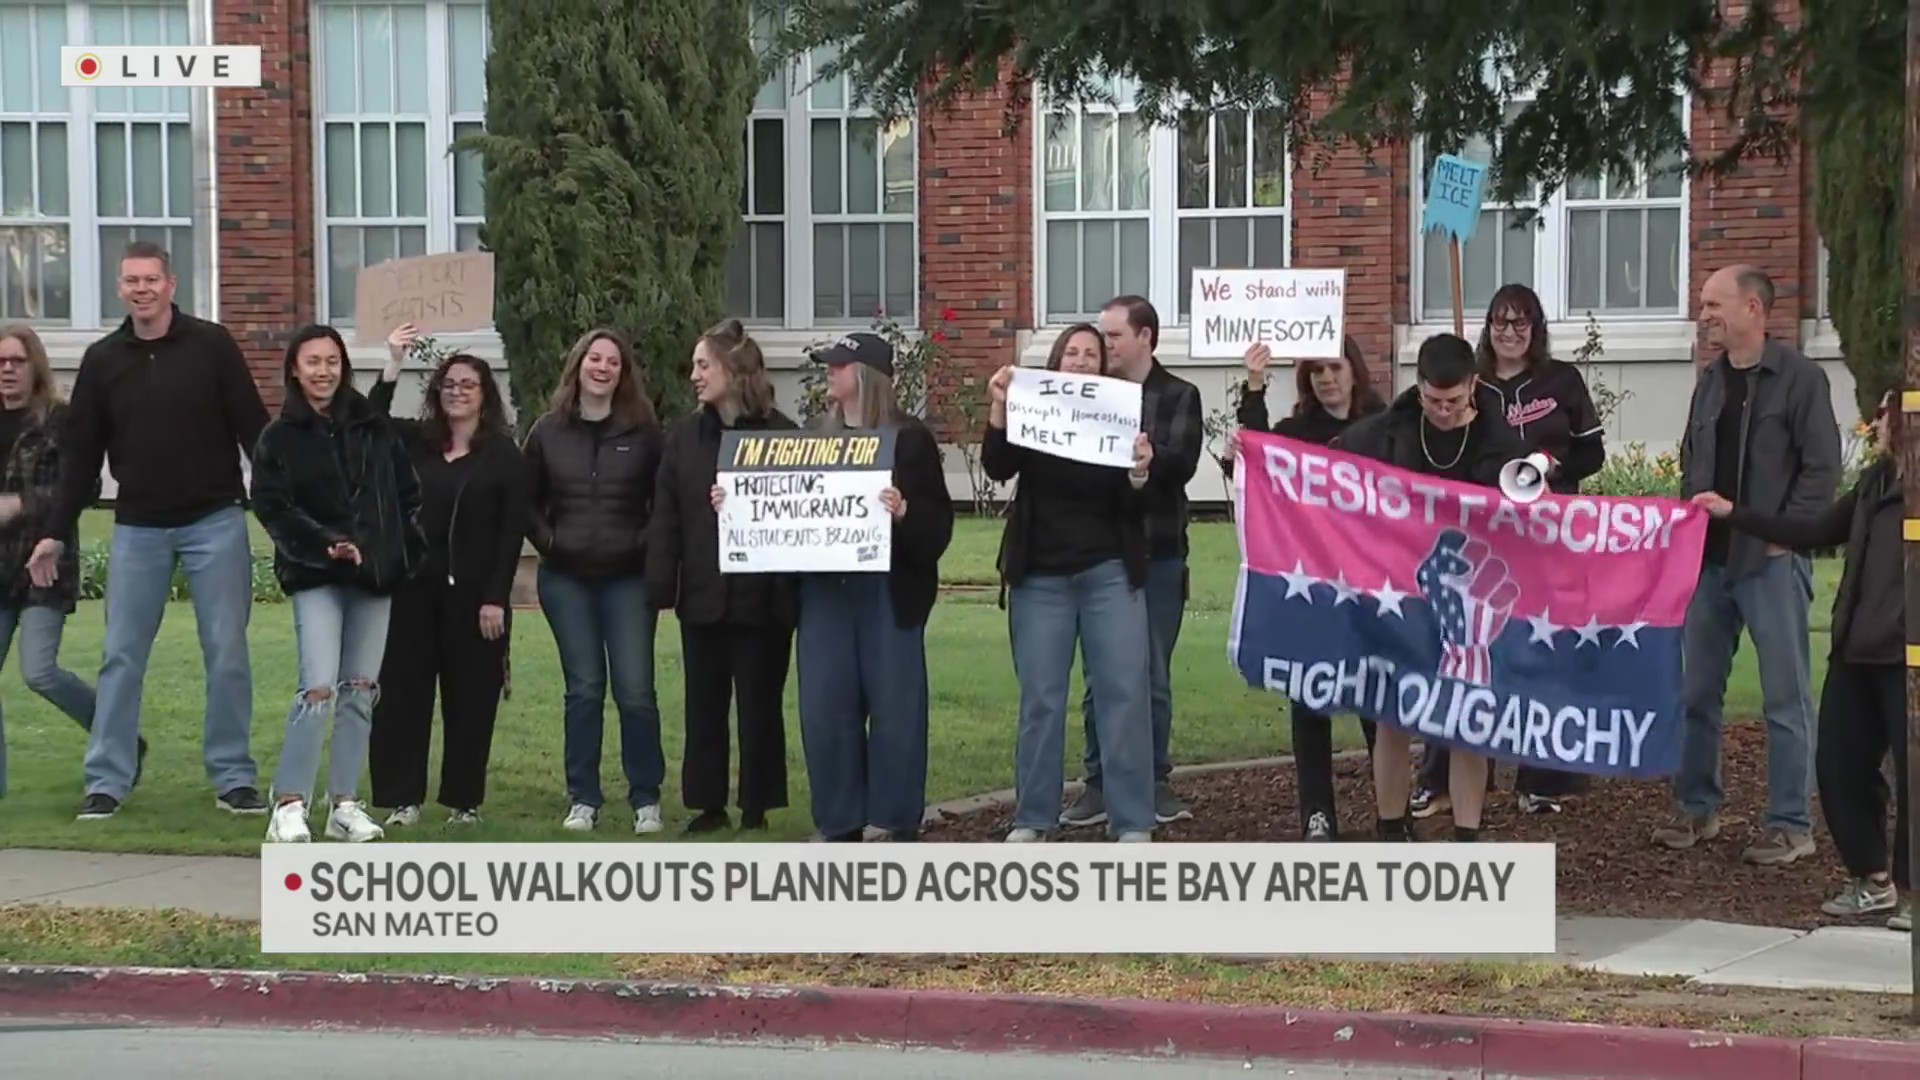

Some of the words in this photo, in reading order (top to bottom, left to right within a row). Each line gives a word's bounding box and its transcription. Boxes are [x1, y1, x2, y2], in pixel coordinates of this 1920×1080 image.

[1438, 158, 1480, 187] MELT
[1436, 182, 1472, 208] ICE
[1200, 276, 1232, 302] We
[1245, 278, 1297, 300] stand
[1305, 280, 1341, 297] with
[1205, 315, 1336, 345] MINNESOTA
[1039, 379, 1099, 399] ICE
[1008, 401, 1062, 421] Disrupts
[733, 437, 765, 467] I'M
[764, 437, 843, 467] FIGHTING
[843, 436, 880, 466] FOR
[1021, 423, 1077, 446] MELT
[1099, 435, 1120, 453] IT
[734, 473, 825, 498] PROTECTING
[1262, 443, 1447, 524] RESIST
[1458, 494, 1688, 555] FASCISM
[751, 494, 868, 522] IMMIGRANTS
[1263, 655, 1396, 715] FIGHT
[1398, 671, 1656, 768] OLIGARCHY
